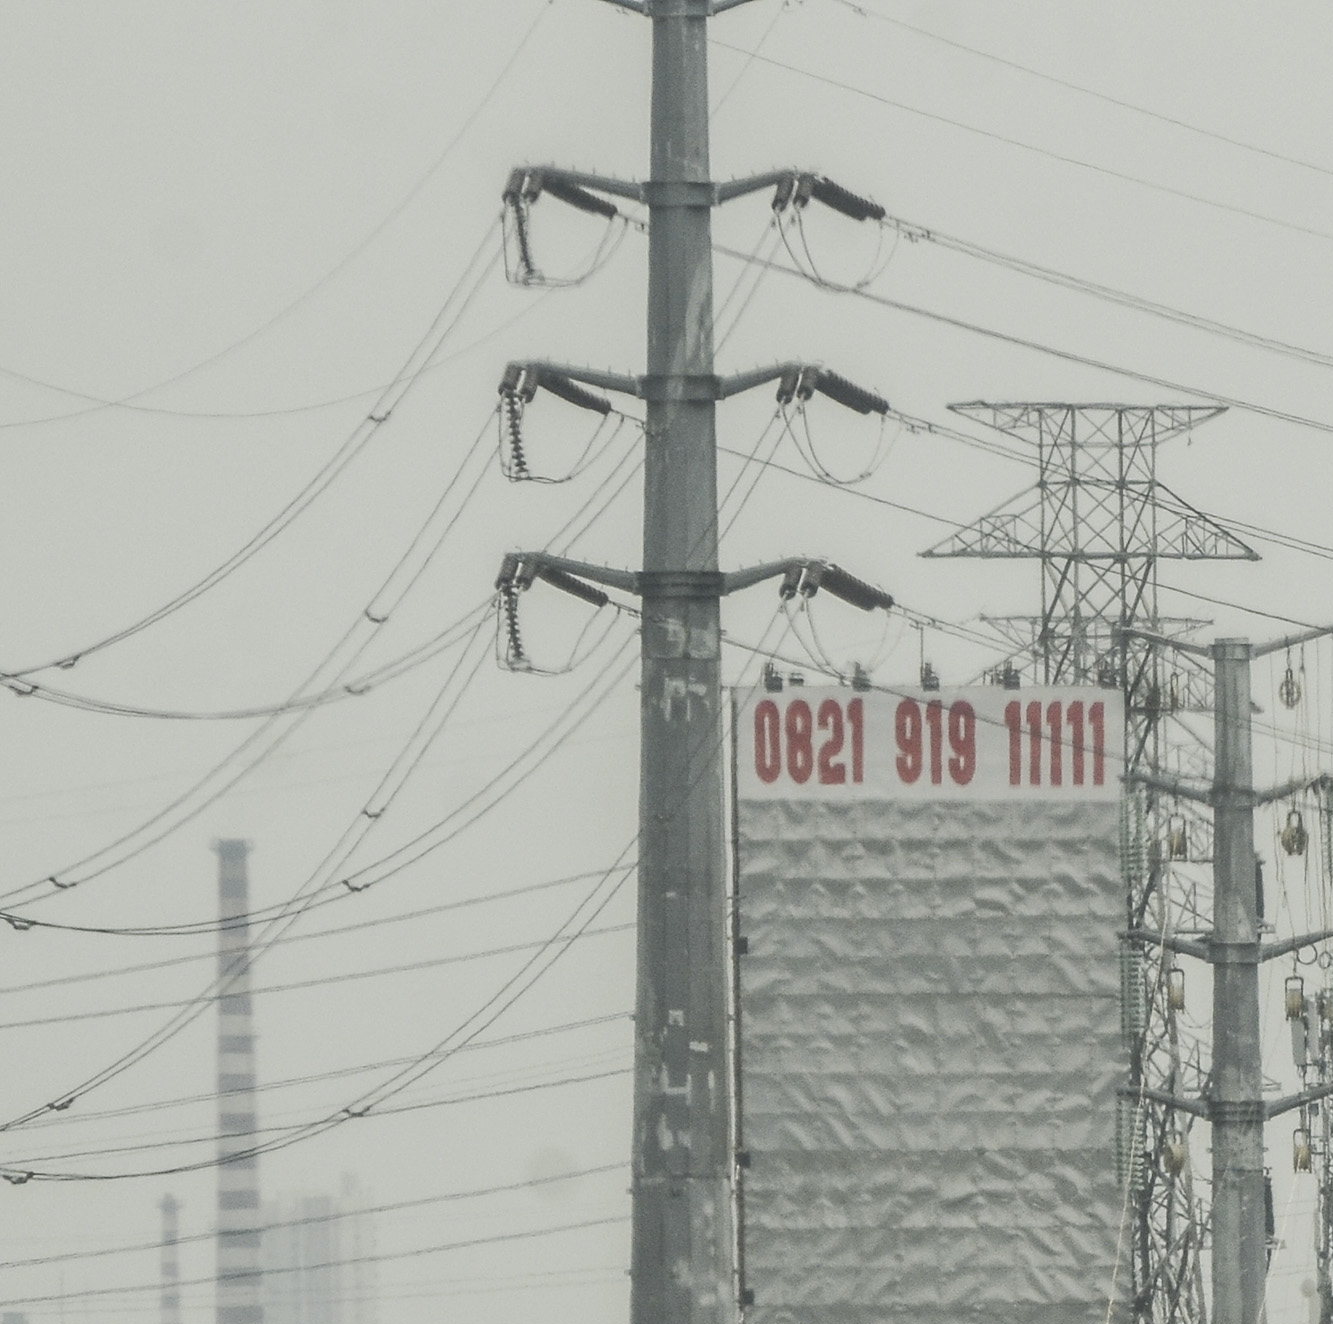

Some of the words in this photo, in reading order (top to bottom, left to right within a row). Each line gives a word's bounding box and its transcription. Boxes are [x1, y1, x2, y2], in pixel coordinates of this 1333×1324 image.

[754, 698, 864, 784] 0821
[895, 698, 976, 785] 919
[1004, 700, 1105, 786] 11111
